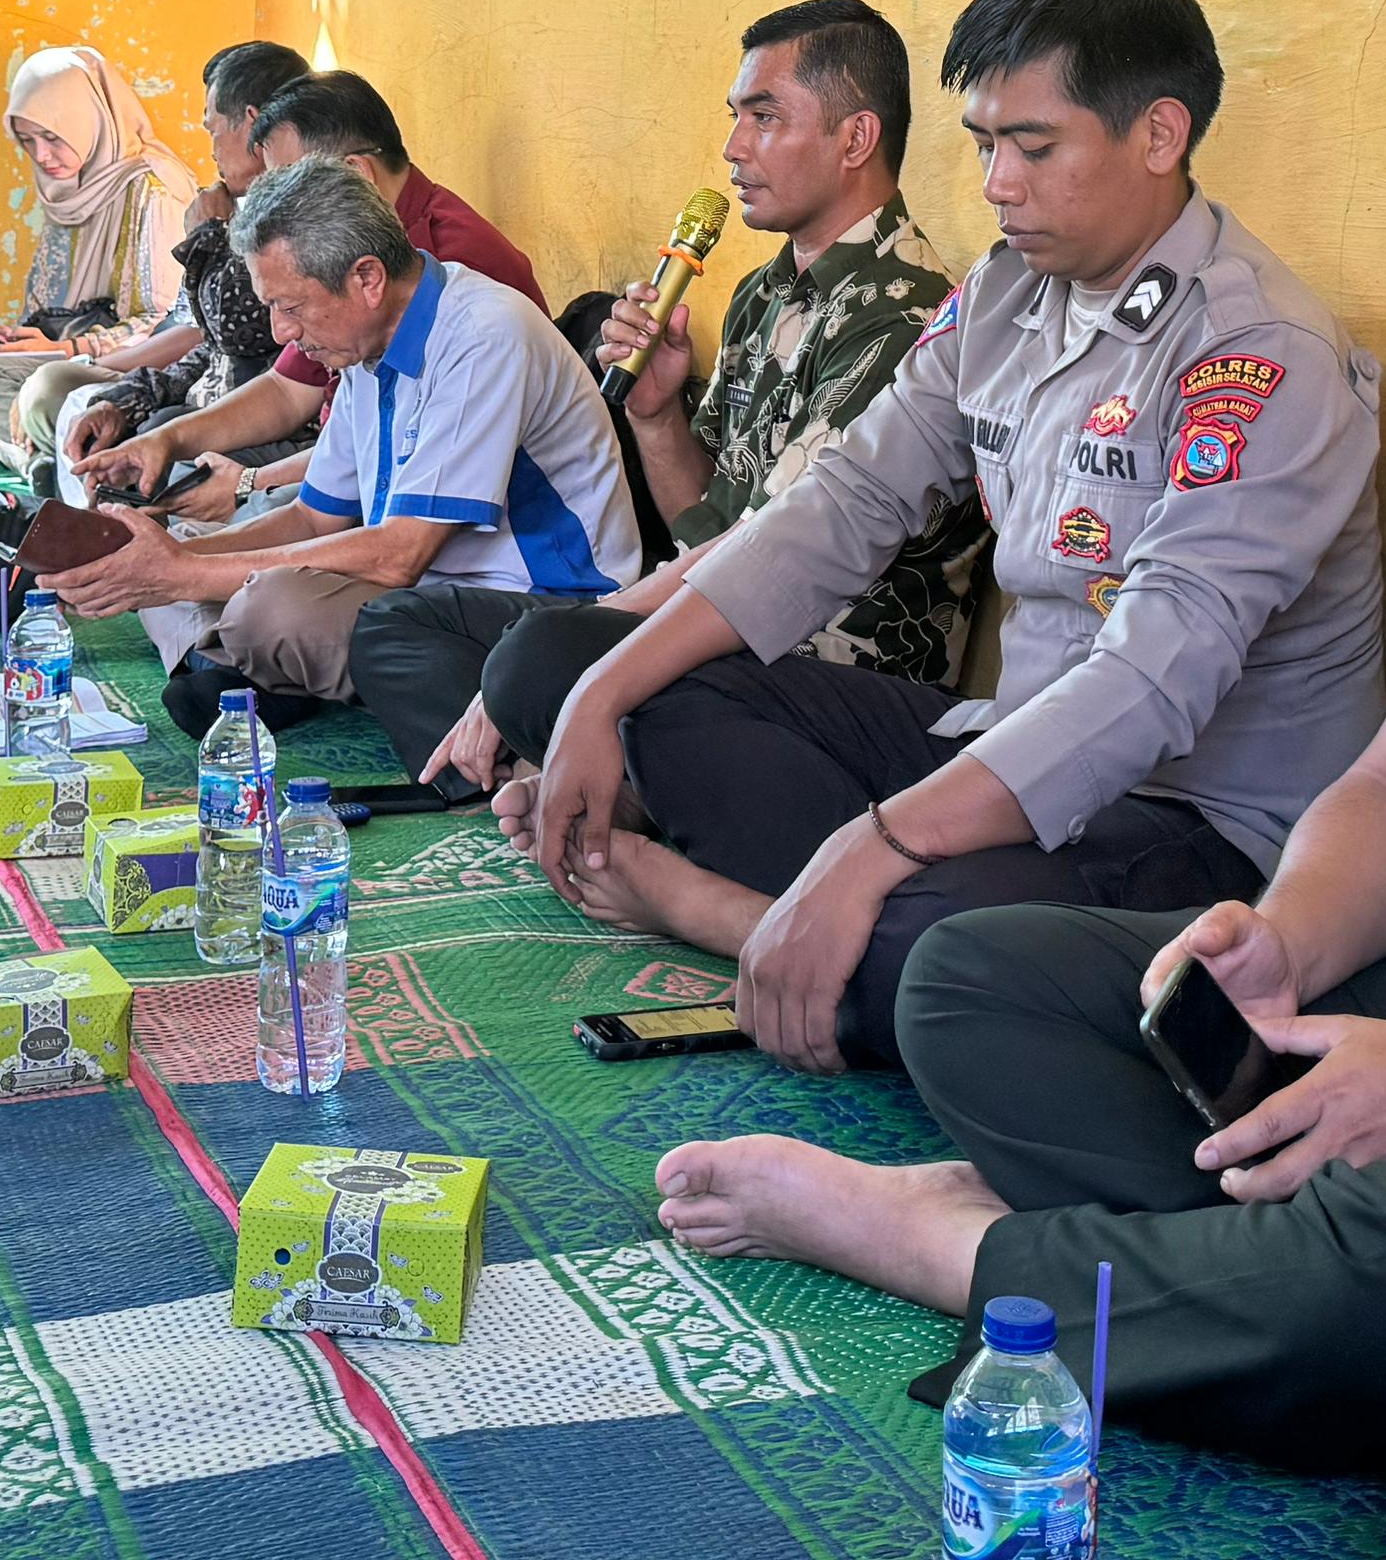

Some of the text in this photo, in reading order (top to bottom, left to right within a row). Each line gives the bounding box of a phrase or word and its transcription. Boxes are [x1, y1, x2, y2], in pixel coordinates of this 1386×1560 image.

[1187, 360, 1273, 385] POLRES
[1223, 372, 1270, 392] SELATAN
[27, 1037, 65, 1051] CAESAR
[326, 1265, 371, 1281] CAESAR
